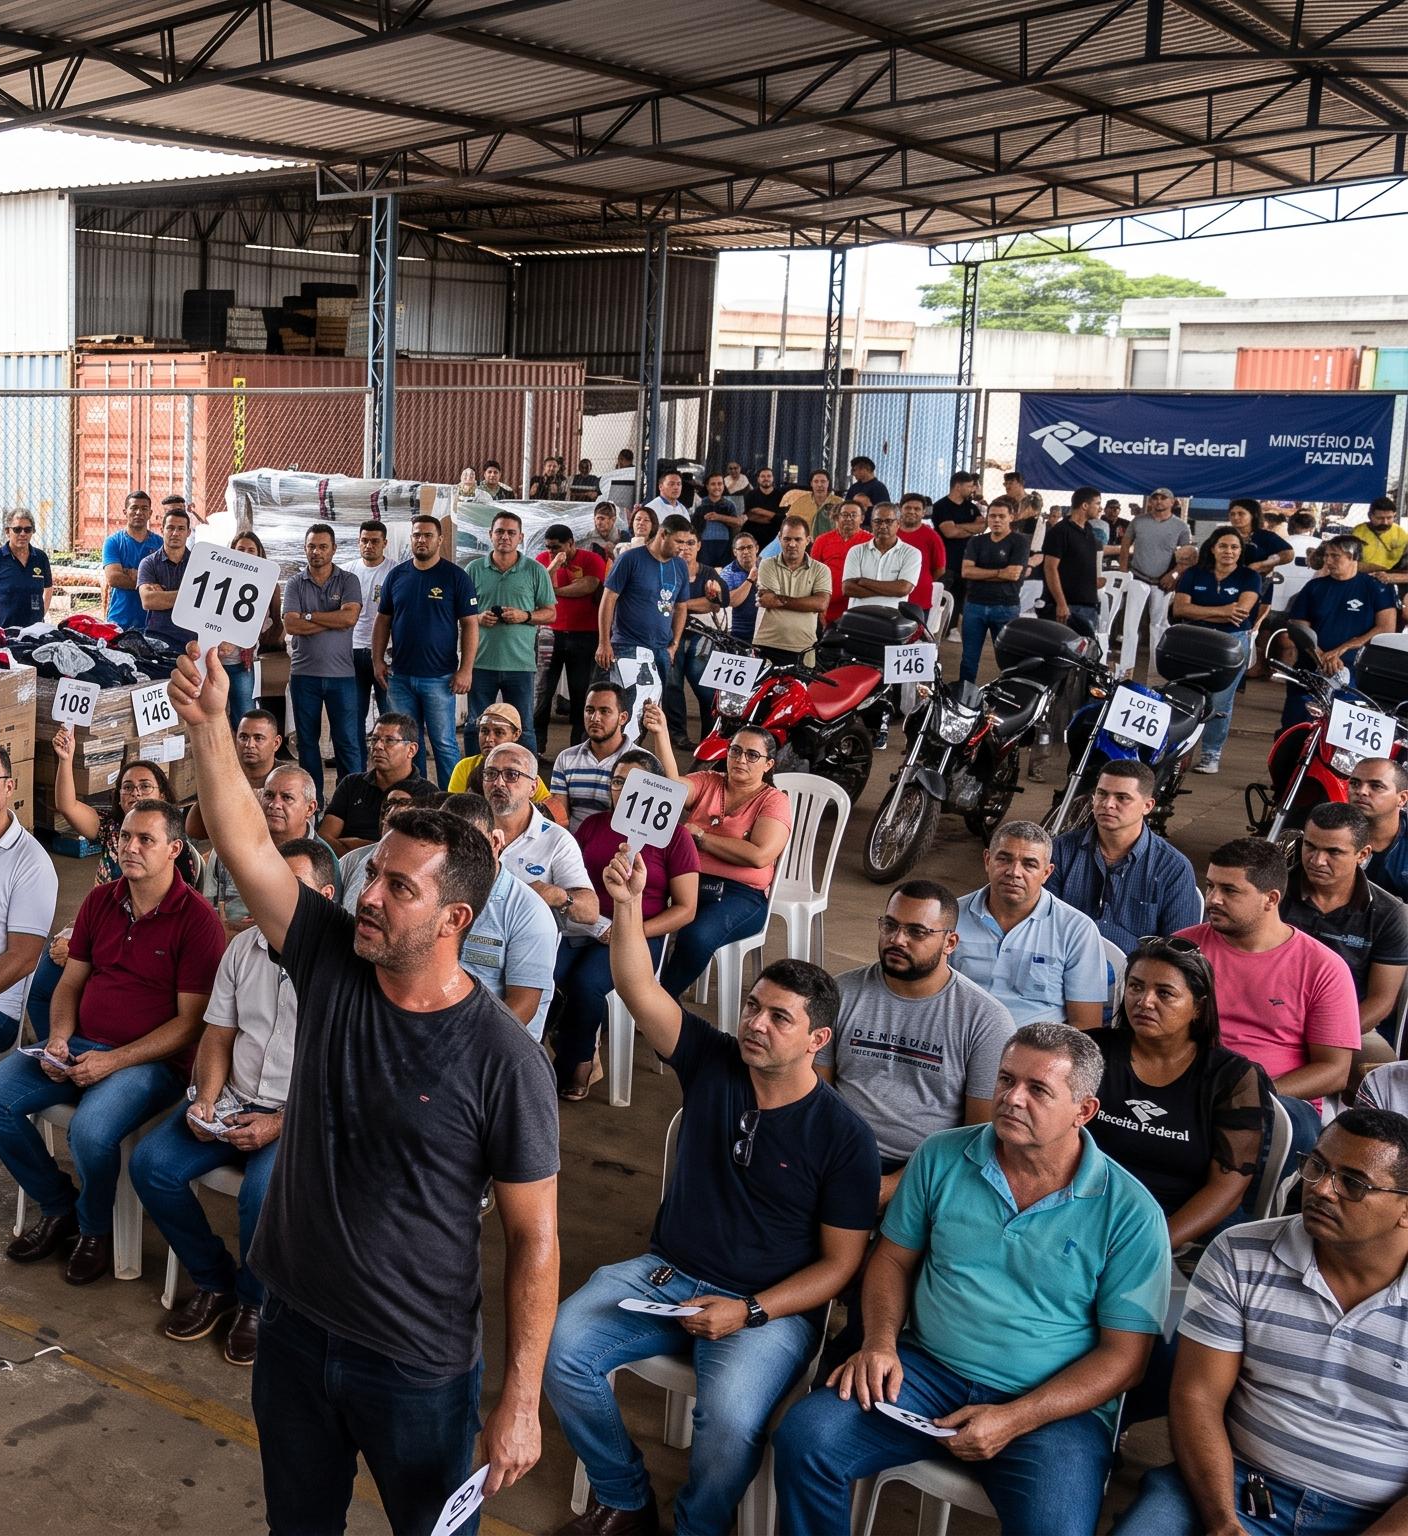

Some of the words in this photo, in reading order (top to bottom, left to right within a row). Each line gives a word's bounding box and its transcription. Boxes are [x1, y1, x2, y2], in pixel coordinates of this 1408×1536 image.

[1098, 435, 1169, 456] Receita
[1172, 437, 1247, 458] Federal
[1269, 433, 1351, 450] MINISTÉRIO
[1354, 436, 1375, 450] DA
[1304, 451, 1374, 466] FAZENDA
[192, 570, 259, 623] 118
[721, 656, 747, 669] LOTE
[896, 647, 921, 658] LOTE
[713, 666, 747, 687] 116
[893, 657, 925, 675] 146
[59, 692, 91, 715] 108
[142, 688, 164, 703] LOTE
[1128, 696, 1158, 715] LOTE
[142, 701, 171, 726] 146
[1119, 708, 1160, 738] 146
[1348, 709, 1381, 728] LOTE
[1342, 721, 1383, 751] 146
[625, 791, 673, 831] 118
[1097, 1109, 1139, 1131] Receita
[1140, 1122, 1190, 1142] Federal
